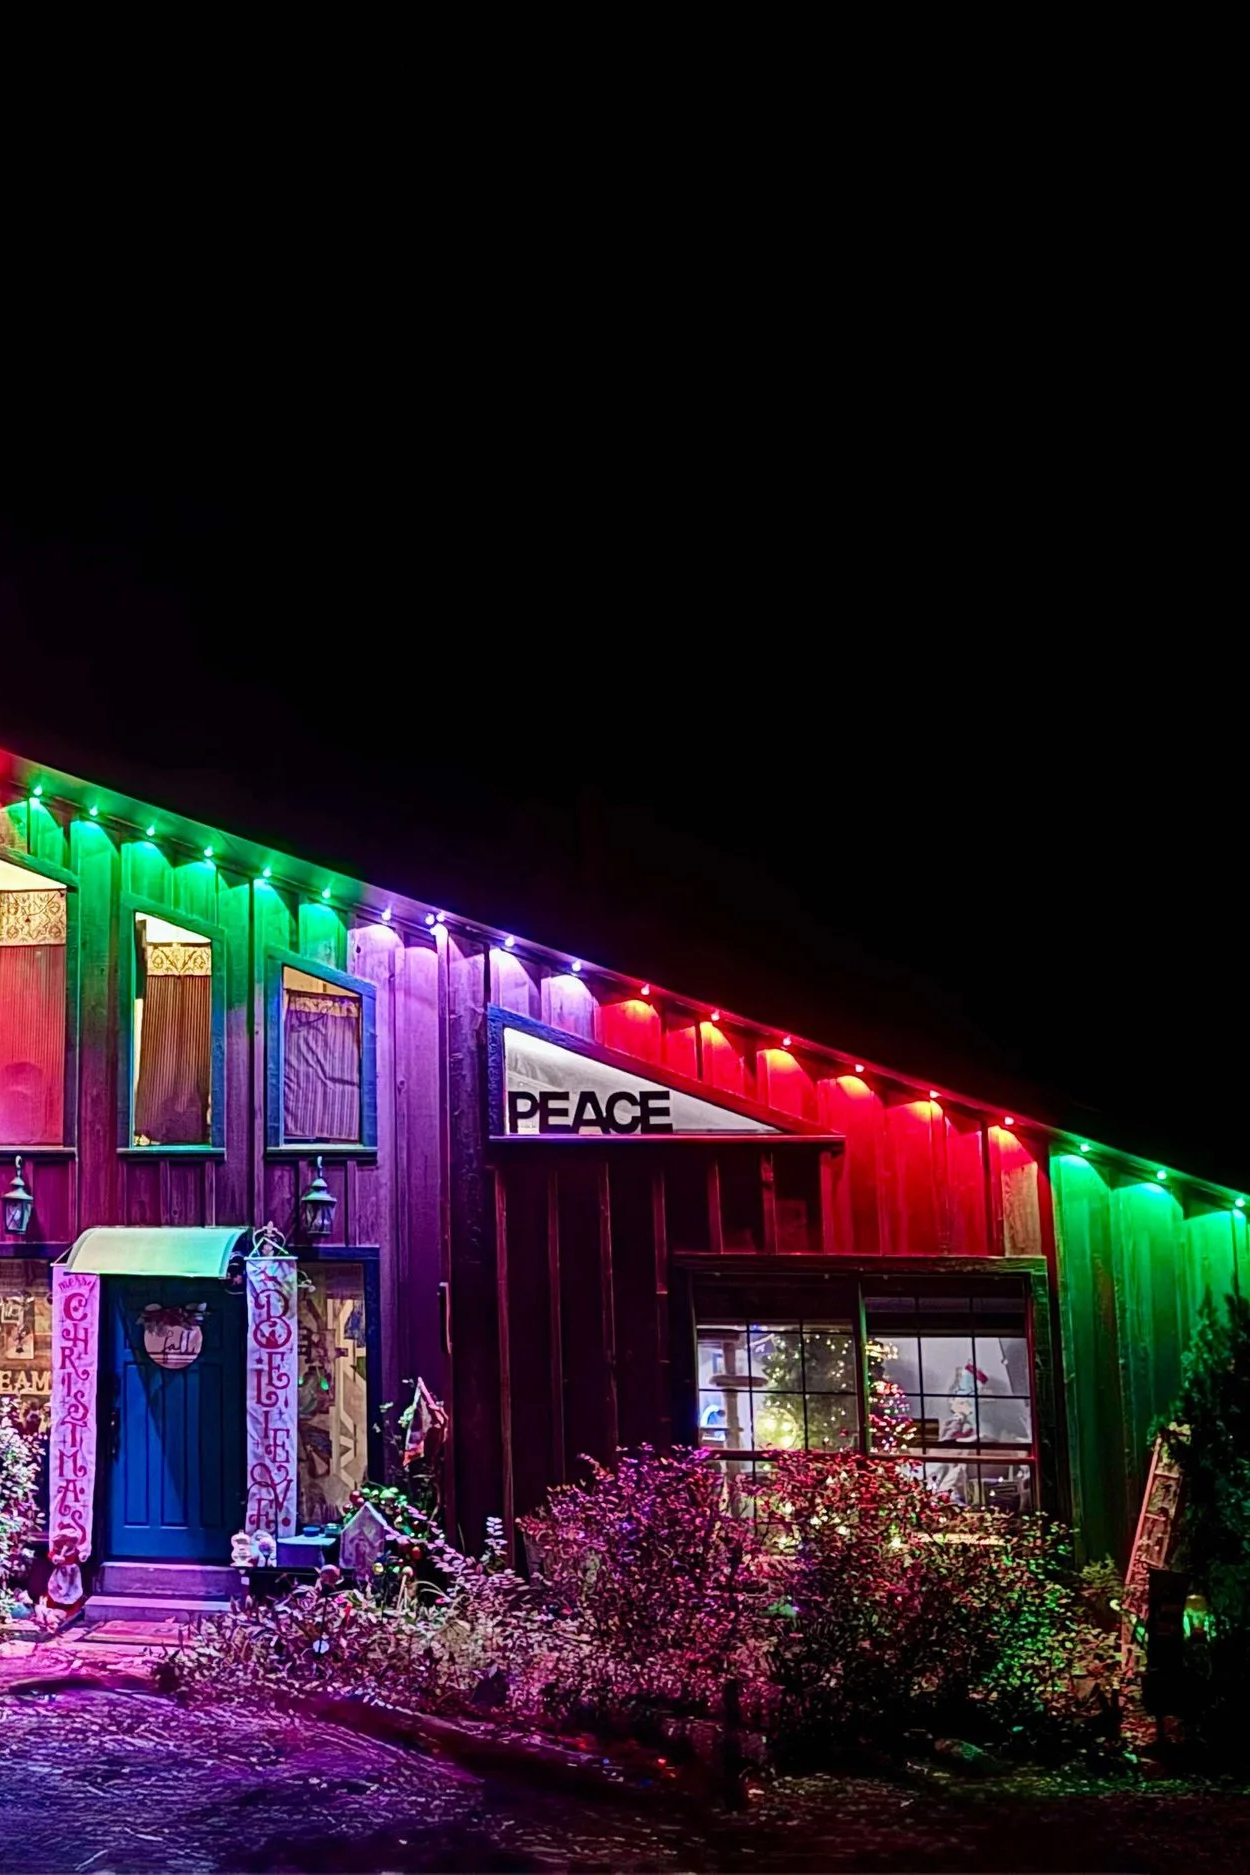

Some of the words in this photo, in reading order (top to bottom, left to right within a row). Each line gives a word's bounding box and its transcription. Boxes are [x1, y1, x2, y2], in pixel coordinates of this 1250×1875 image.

[508, 1091, 673, 1134] PEACE
[57, 1293, 90, 1546] CHRISTMAS
[249, 1289, 293, 1533] BELIEVE
